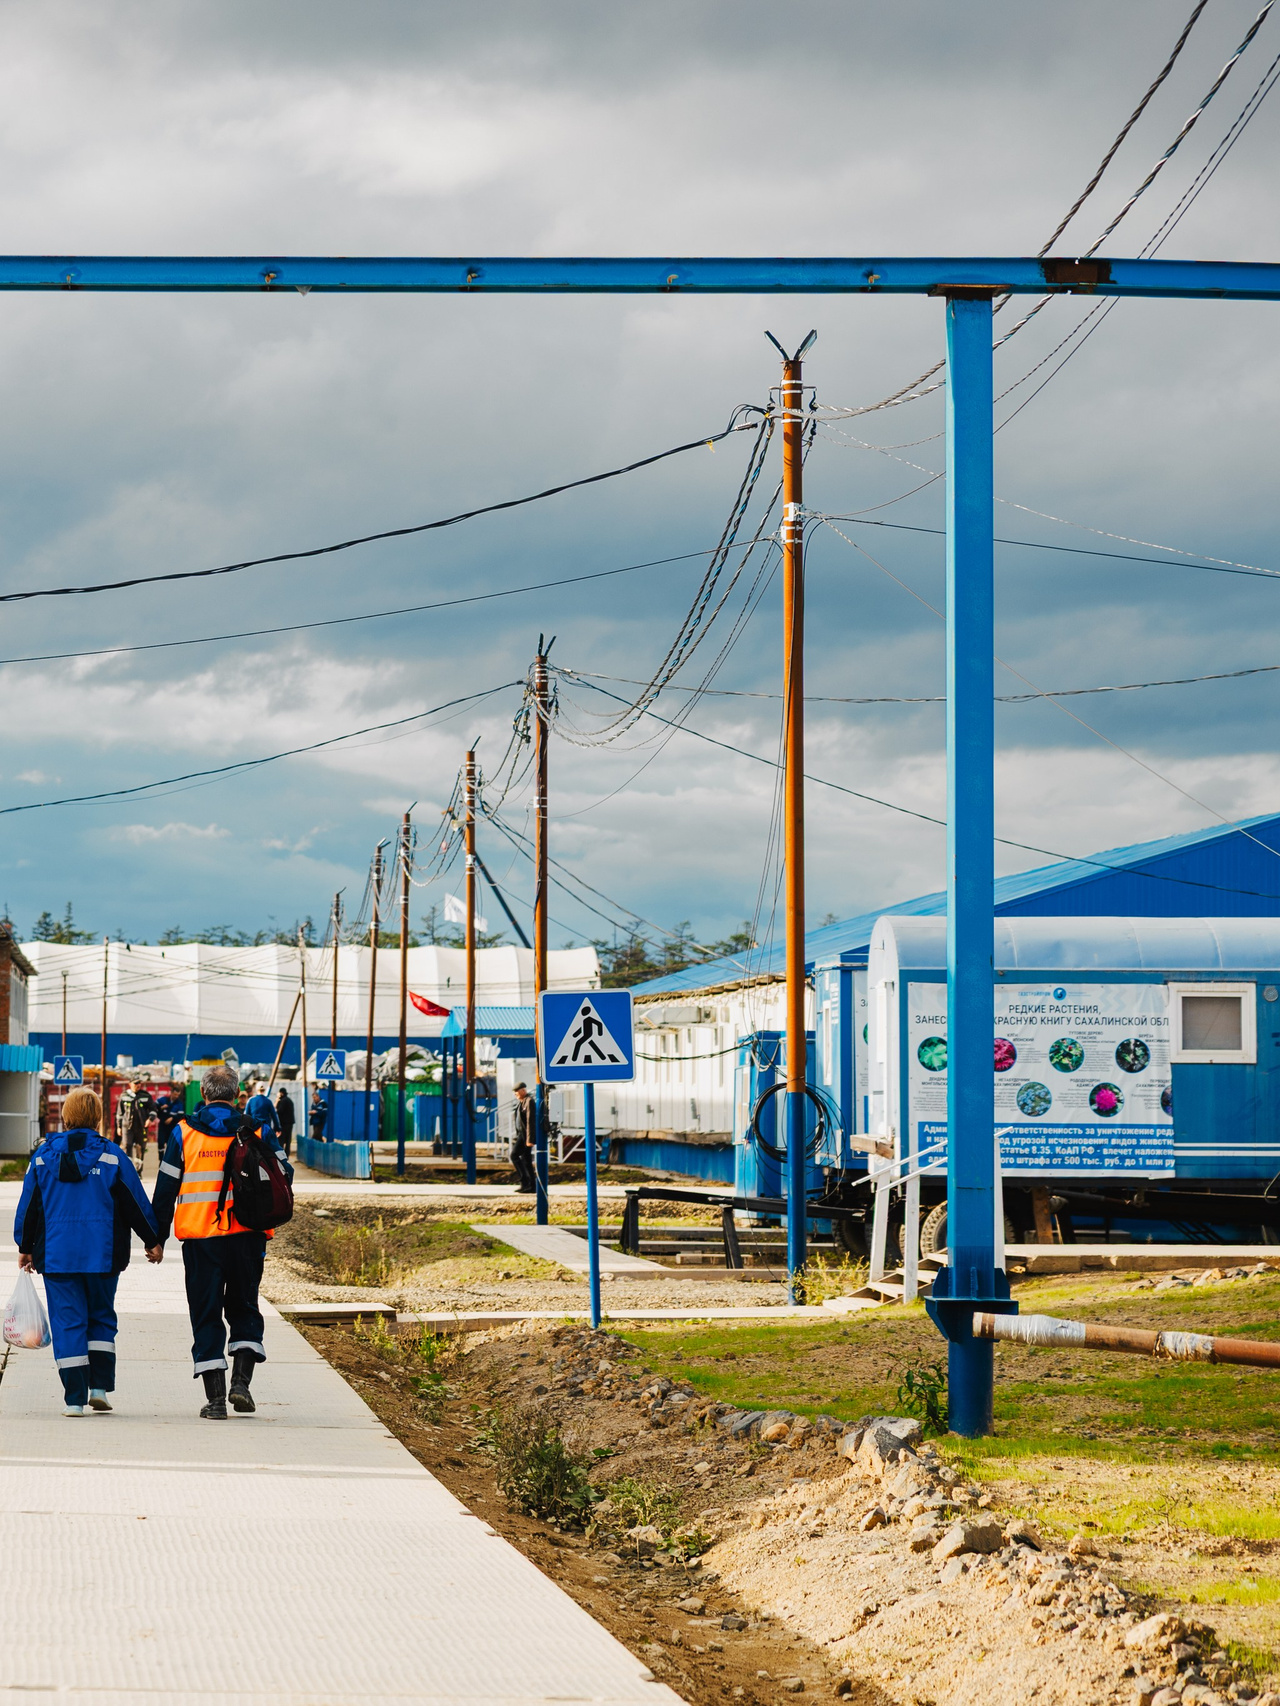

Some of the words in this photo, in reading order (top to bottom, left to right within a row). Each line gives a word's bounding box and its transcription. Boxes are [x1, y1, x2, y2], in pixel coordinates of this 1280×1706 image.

[1008, 1004, 1047, 1015] РЕДКИЕ
[1049, 1004, 1102, 1016] РАСТЕНИЯ,
[1040, 1016, 1072, 1026] КНИГУ
[1074, 1014, 1148, 1027] САХАЛИНСКОЙ
[1096, 1127, 1155, 1137] уничтожение
[1012, 1135, 1046, 1147] угрозой
[1110, 1138, 1138, 1146] видов
[1000, 1147, 1030, 1155] статье
[1031, 1146, 1053, 1155] 8.35.
[1055, 1146, 1080, 1155] КоАП
[1081, 1146, 1095, 1155] РФ
[1102, 1148, 1133, 1156] влечет
[1016, 1155, 1051, 1167] штрафа
[1051, 1157, 1062, 1165] от
[1064, 1156, 1081, 1165] 500
[1104, 1157, 1123, 1167] руб.
[1124, 1158, 1136, 1166] до
